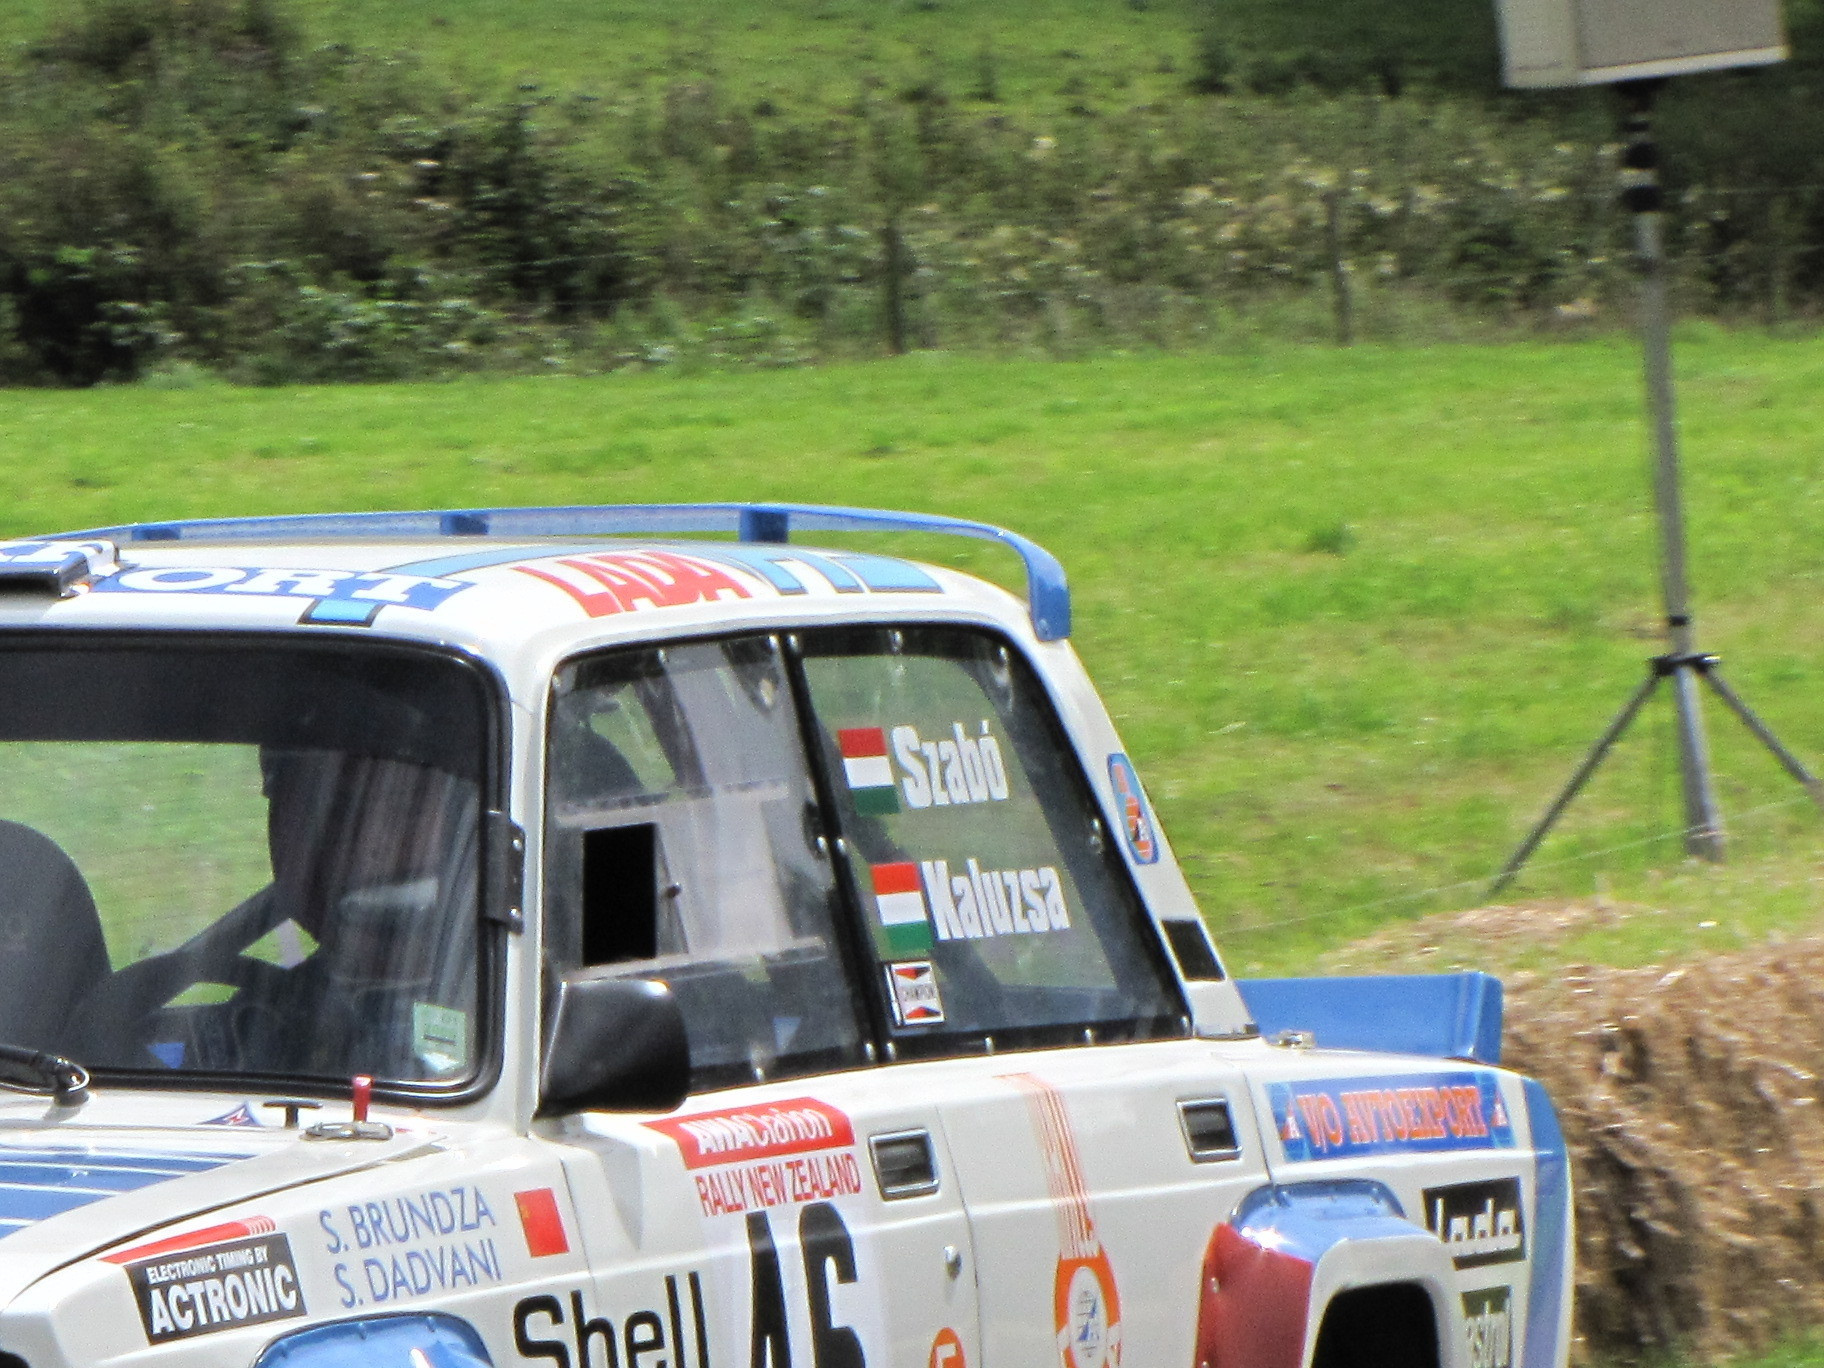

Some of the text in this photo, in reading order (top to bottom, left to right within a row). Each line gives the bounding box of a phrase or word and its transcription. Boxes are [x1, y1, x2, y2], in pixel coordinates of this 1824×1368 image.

[511, 551, 753, 618] LADA
[891, 720, 1009, 809] Szabó
[694, 1153, 863, 1218] RALLY NEW ZEALAND
[319, 1186, 496, 1254] S. BRUNDZA
[1435, 1198, 1522, 1244] lada
[146, 1245, 268, 1285] ELECTRONIC TIMING BY
[334, 1238, 502, 1308] S. DADVANI
[150, 1264, 297, 1335] ACTRONIC
